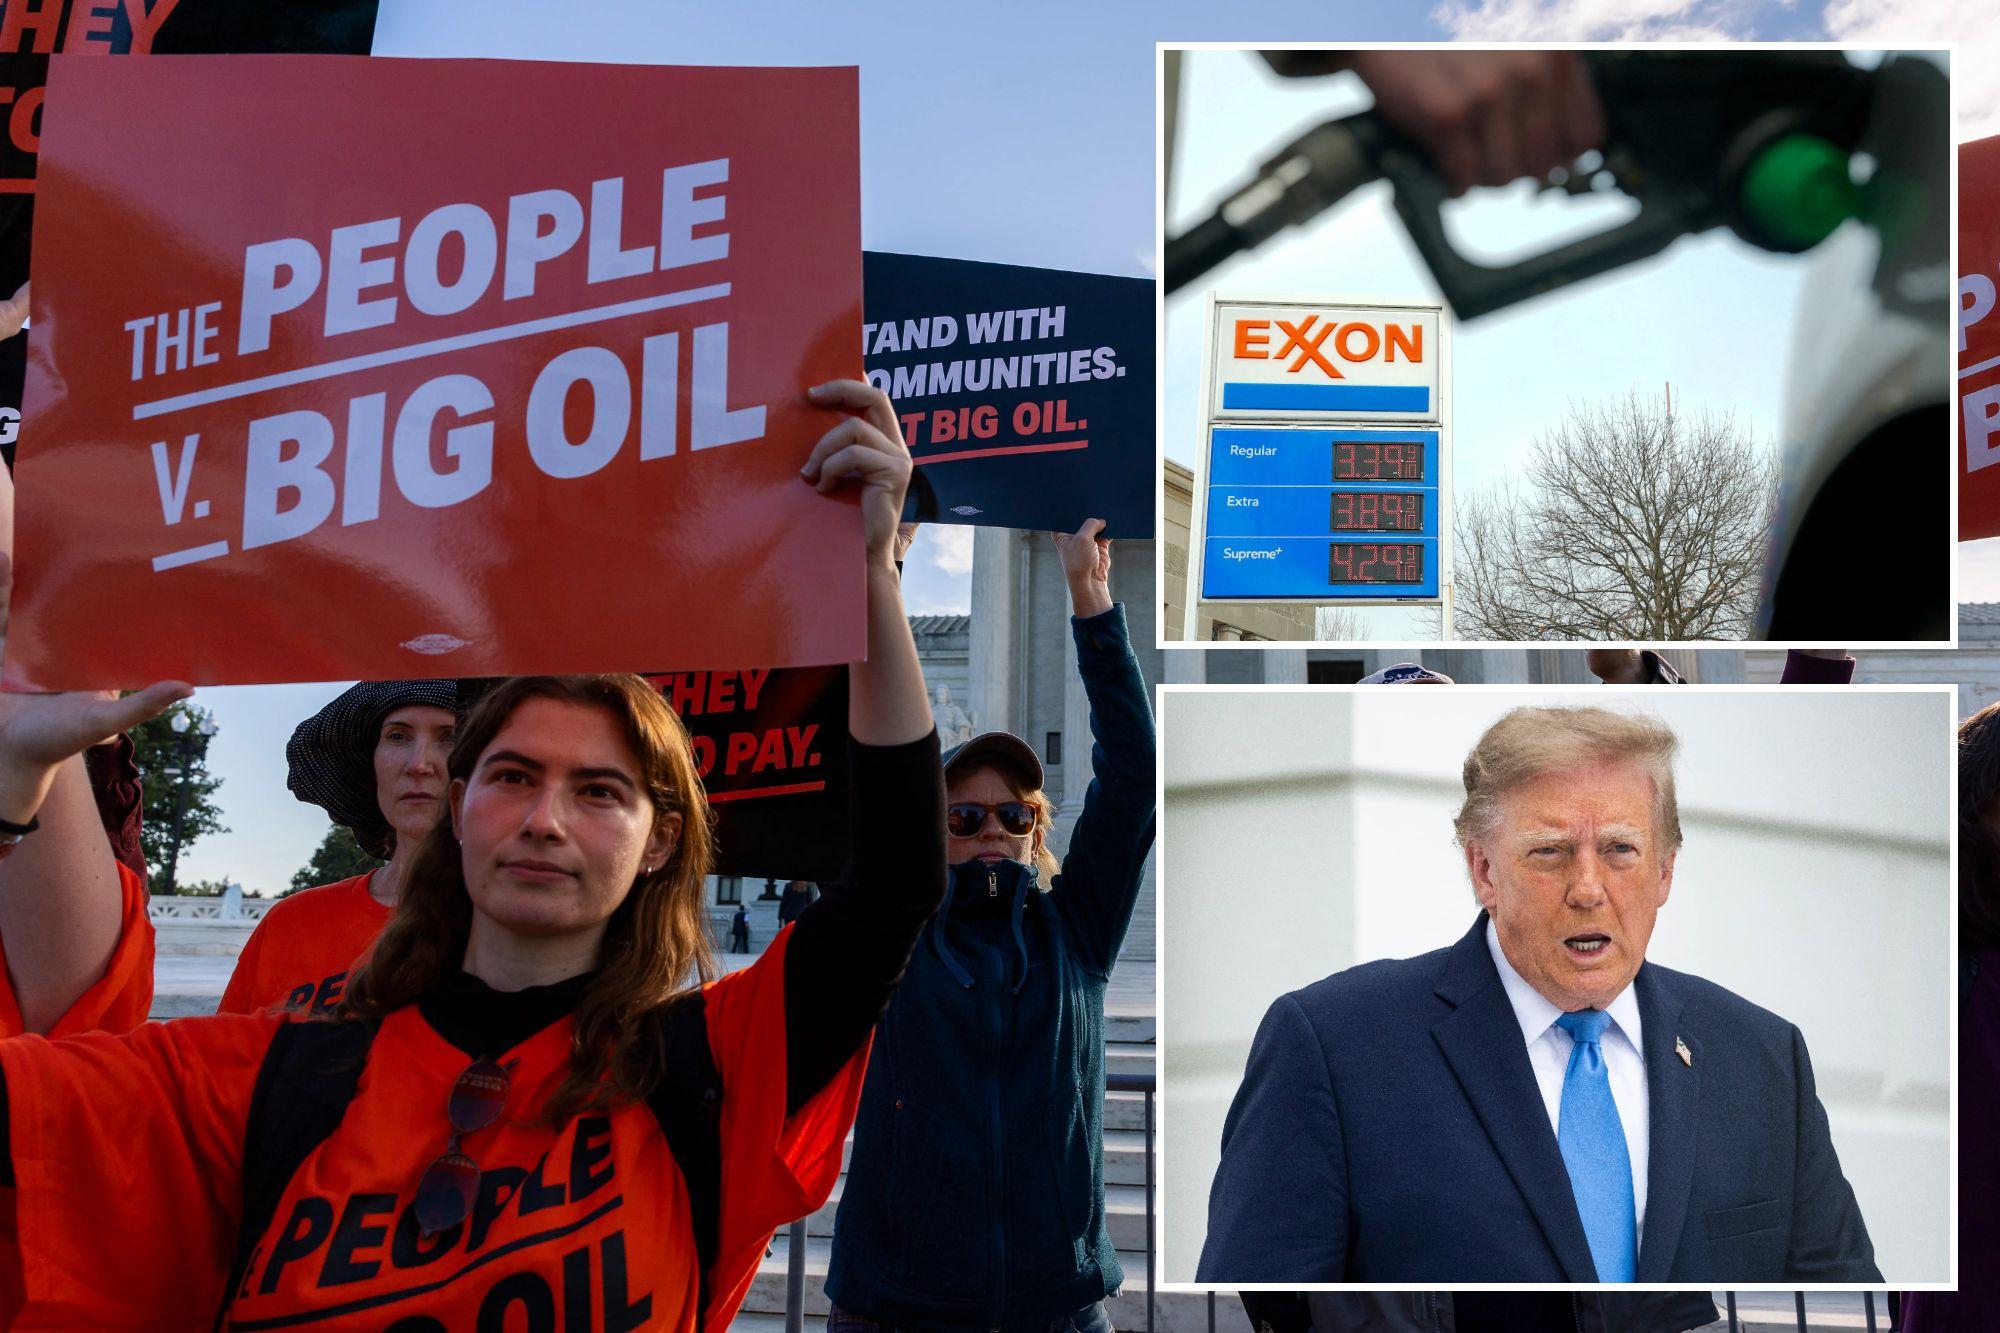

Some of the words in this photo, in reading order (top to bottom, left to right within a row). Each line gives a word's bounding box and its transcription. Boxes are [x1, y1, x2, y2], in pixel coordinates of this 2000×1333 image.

[124, 301, 222, 382] THE
[237, 157, 730, 356] PEOPLE
[966, 305, 1066, 345] WITH
[1233, 315, 1423, 379] EXXON
[150, 433, 211, 526] V.
[242, 374, 496, 551] BIG
[526, 322, 767, 480] OIL
[931, 405, 999, 444] BIG
[1012, 399, 1088, 436] OIL.
[1230, 445, 1278, 459] Regular
[1226, 495, 1259, 507] Extra
[725, 724, 821, 776] PAY.
[258, 1117, 616, 1295] PEOPLE
